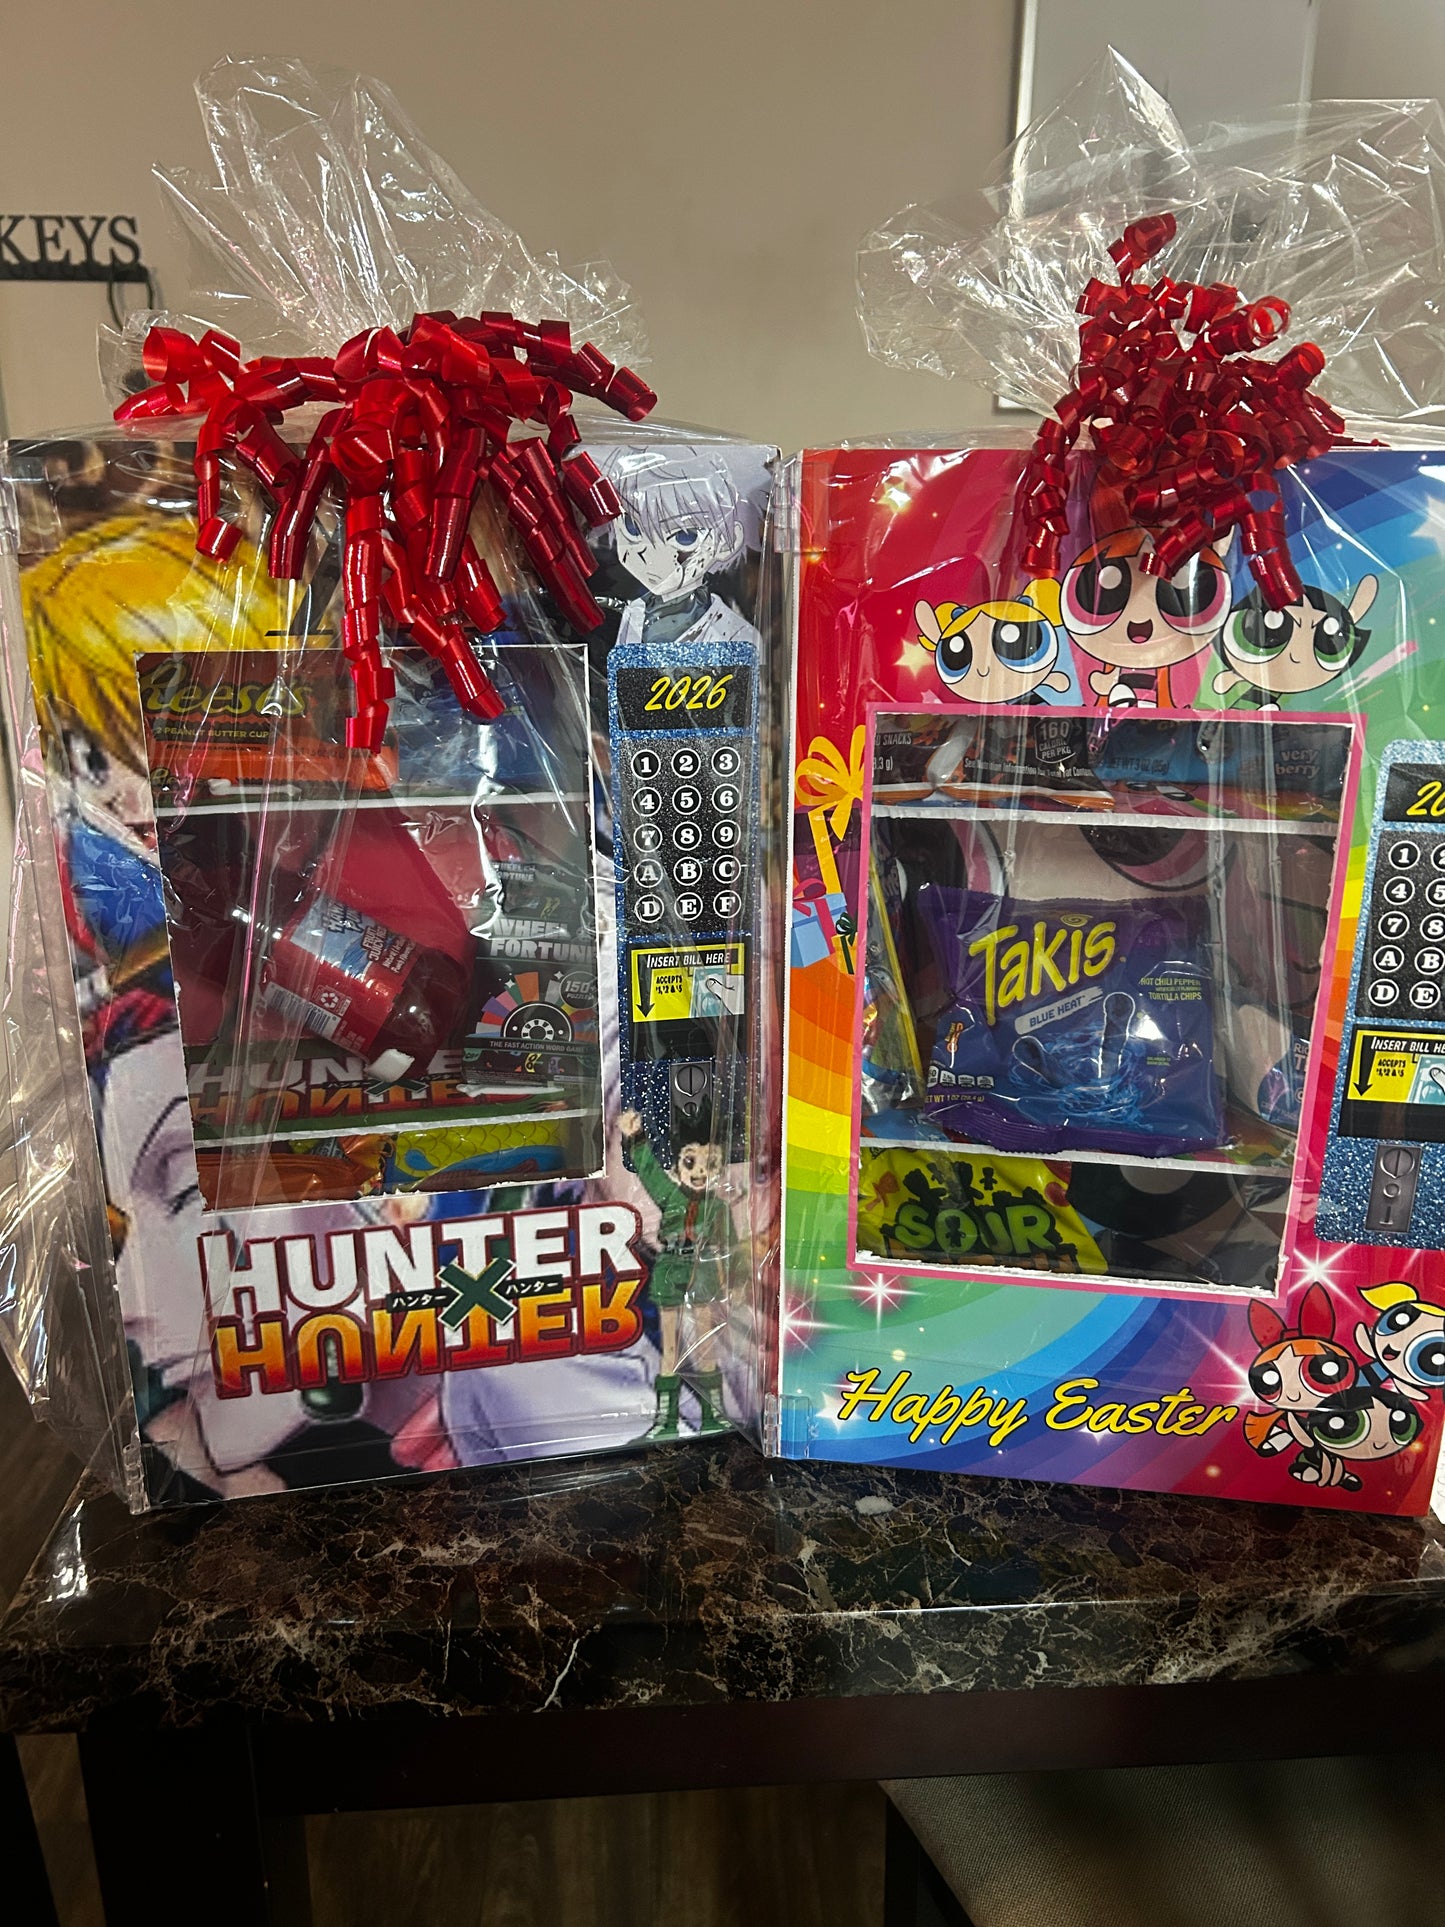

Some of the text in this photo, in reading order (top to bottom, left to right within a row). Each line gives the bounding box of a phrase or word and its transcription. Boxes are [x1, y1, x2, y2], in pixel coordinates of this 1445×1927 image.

[0, 215, 140, 265] KEYS
[644, 673, 734, 712] 2026
[208, 728, 248, 738] BUTTER
[882, 733, 912, 745] SNACKS
[1040, 721, 1069, 740] 160
[641, 753, 732, 773] 1 2 3
[1041, 750, 1056, 760] PER
[1282, 750, 1319, 763] very
[1275, 763, 1320, 778] berry
[640, 790, 733, 810] 4 5 6
[641, 826, 733, 846] 7 8 9
[1398, 848, 1410, 863] 1
[641, 861, 736, 881] A B C
[1391, 883, 1407, 899] 4
[642, 896, 736, 917] D E F
[1387, 918, 1444, 935] 7 8
[646, 952, 731, 969] INSERT BILL HERE
[1379, 951, 1440, 969] A B
[656, 975, 683, 985] ACCEPTS
[1140, 977, 1153, 986] HOT
[1148, 991, 1202, 1001] TORTILLA CHIPS
[1374, 985, 1434, 1003] D E
[1029, 1007, 1055, 1027] BLUE
[504, 1041, 520, 1049] FAST
[1370, 1036, 1408, 1051] INSERT
[1409, 1041, 1431, 1054] BILL
[1378, 1059, 1407, 1068] ACCEPTS
[894, 1204, 1057, 1255] SOUR
[199, 1203, 645, 1319] HUNTER
[391, 1294, 448, 1308] ハンター
[505, 1281, 559, 1295] ハンター
[837, 1367, 1239, 1447] Happy Easter
